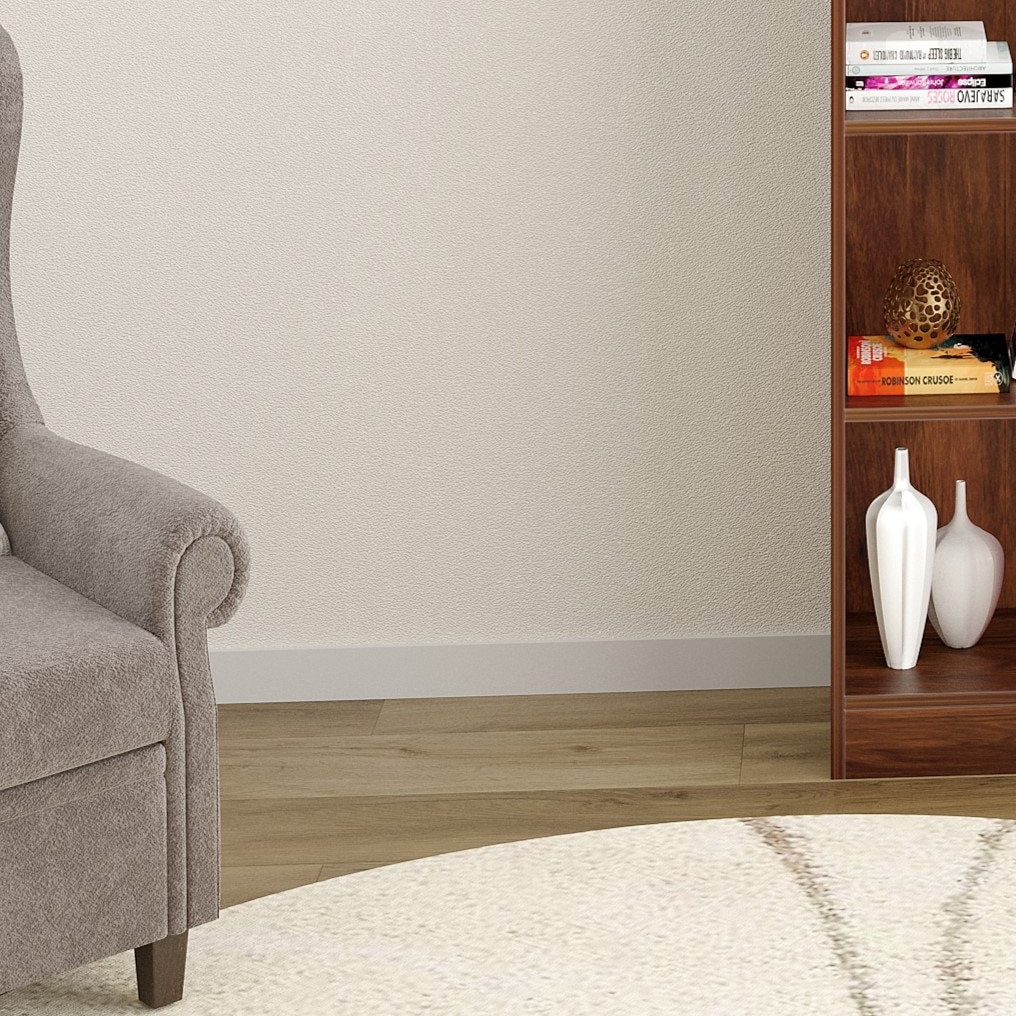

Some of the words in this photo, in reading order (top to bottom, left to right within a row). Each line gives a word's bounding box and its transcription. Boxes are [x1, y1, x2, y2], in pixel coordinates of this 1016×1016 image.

[928, 48, 944, 60] SLEEP
[945, 48, 954, 60] BIG
[953, 48, 962, 60] THE
[957, 78, 986, 87] Eclipse
[928, 90, 956, 104] ROSES
[956, 90, 1005, 103] SARAJEVO
[881, 375, 921, 386] ROBINSON
[922, 375, 954, 385] CRUSOE
